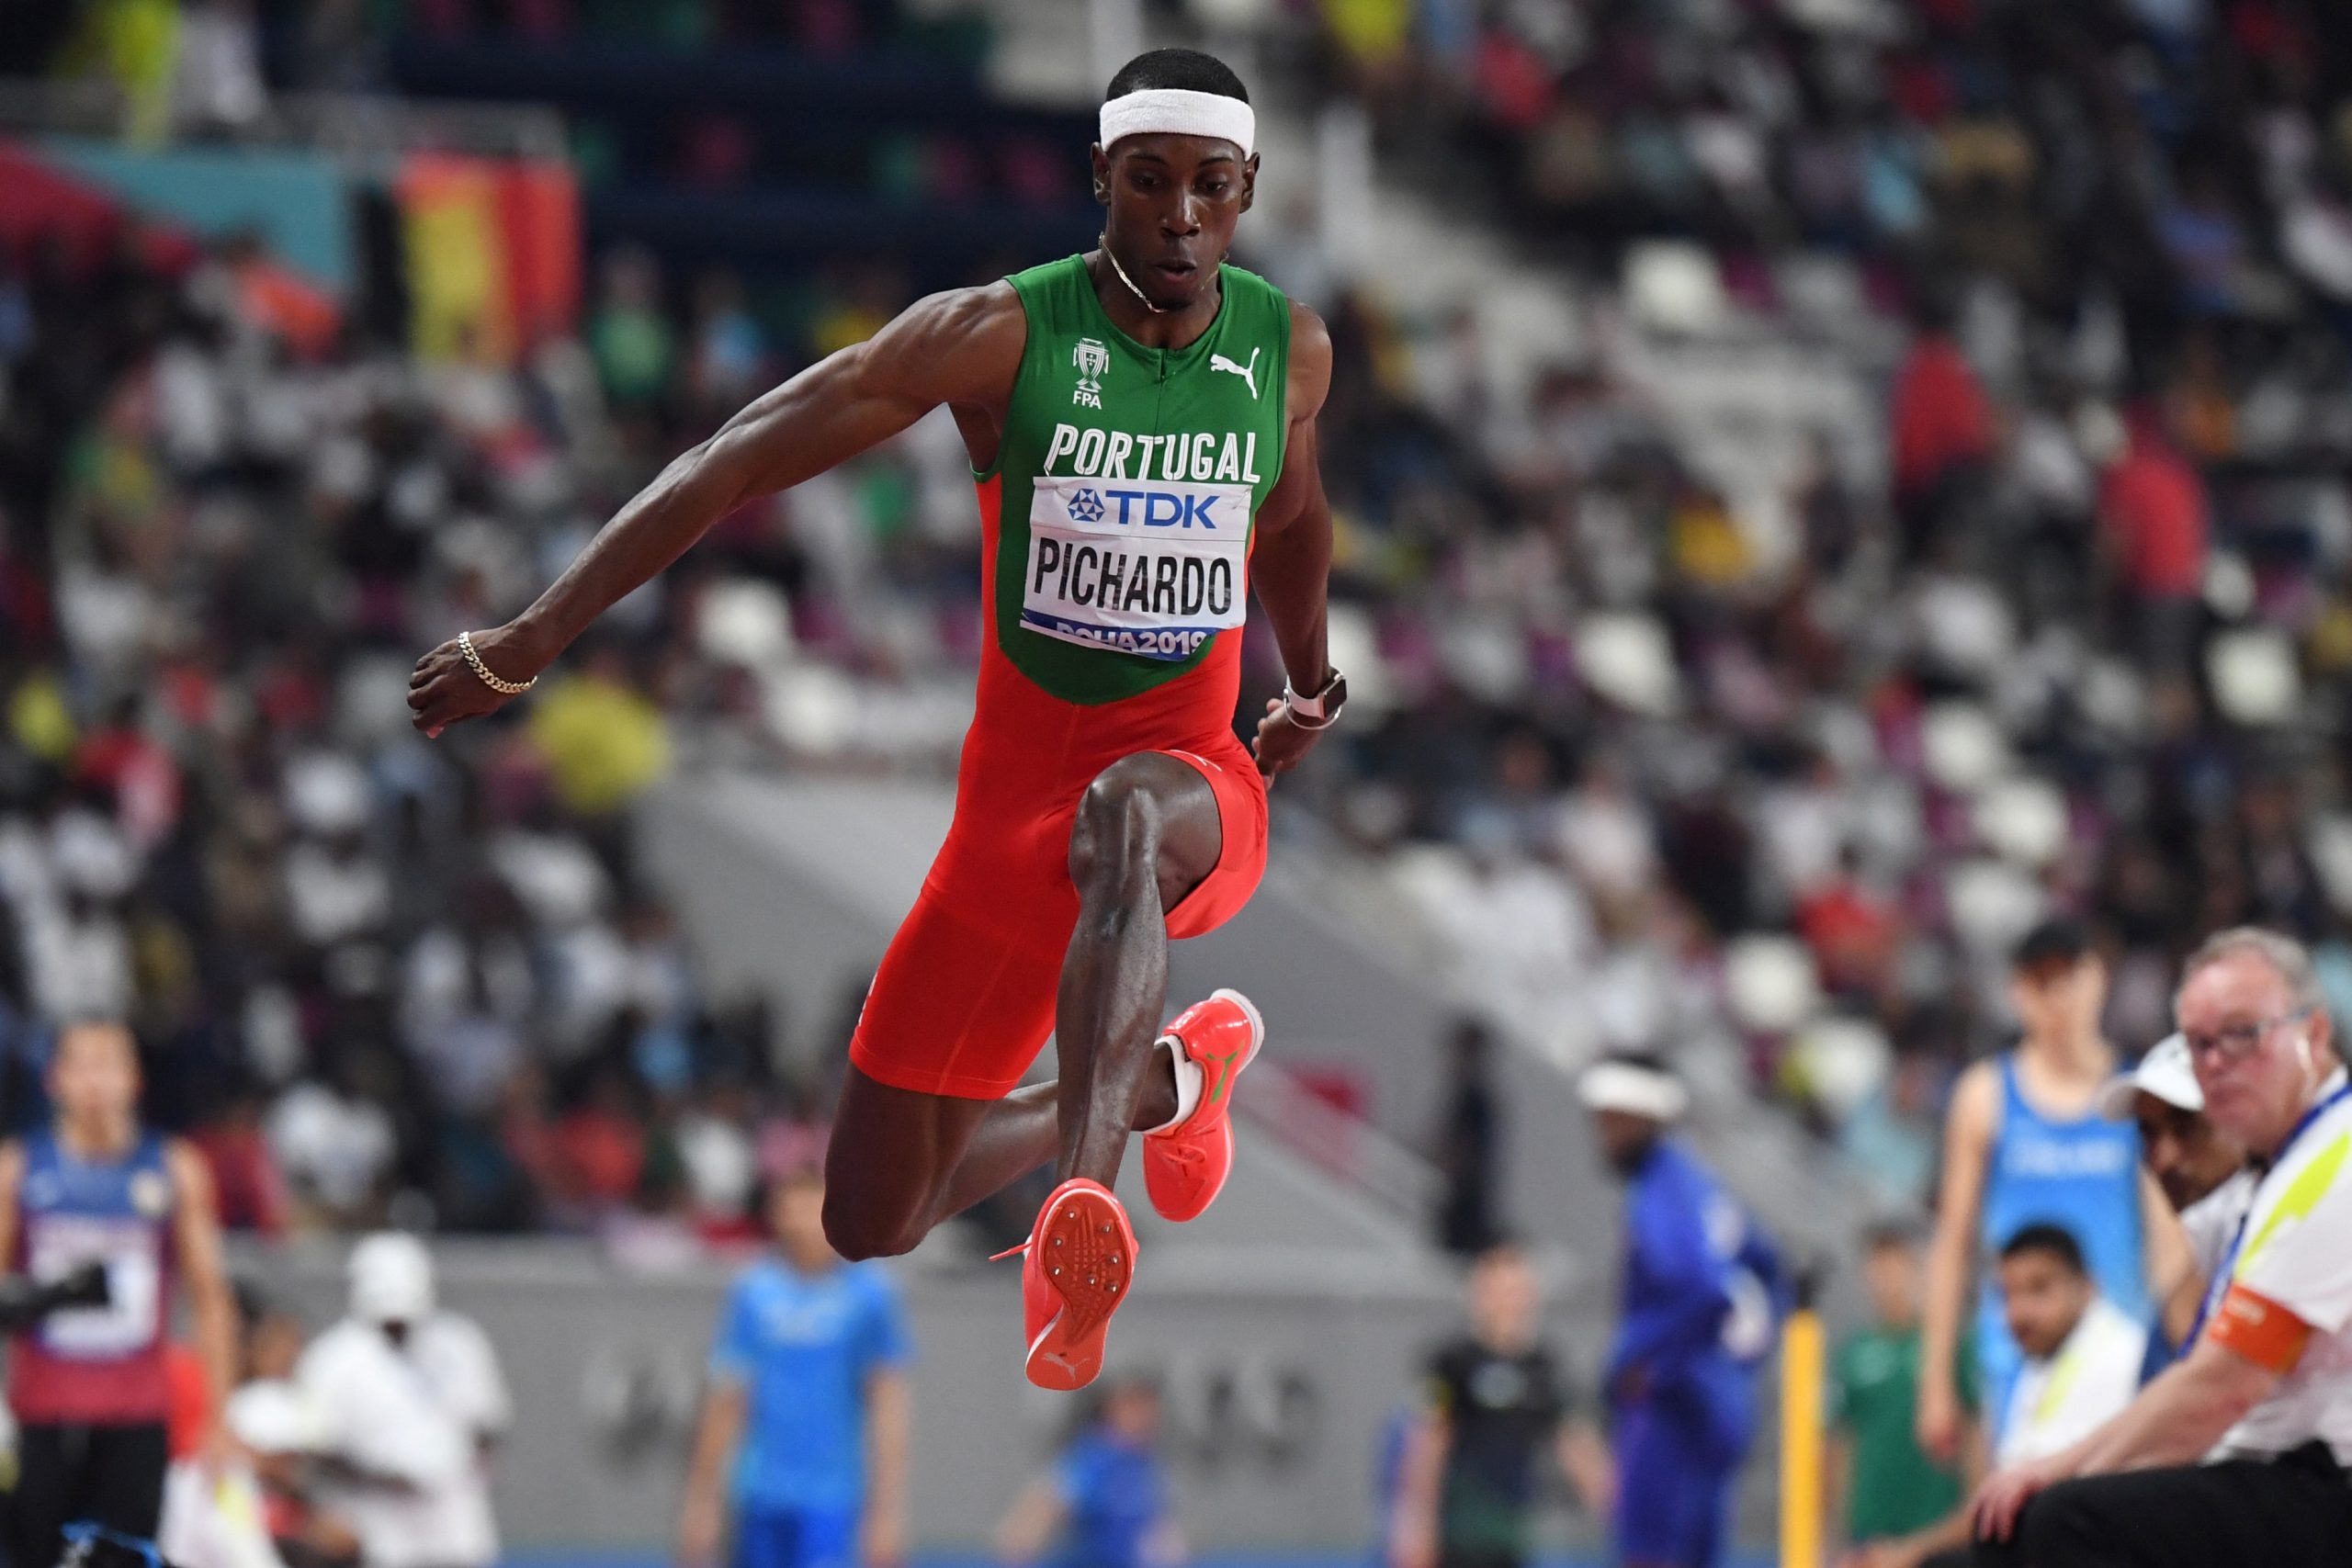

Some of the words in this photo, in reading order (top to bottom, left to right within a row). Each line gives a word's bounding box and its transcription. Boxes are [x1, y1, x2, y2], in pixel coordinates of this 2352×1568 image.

[1072, 390, 1102, 410] FPA
[1045, 423, 1261, 483] PORTUGAL
[1105, 491, 1220, 529] TDK
[1034, 537, 1231, 615] PICHARDO
